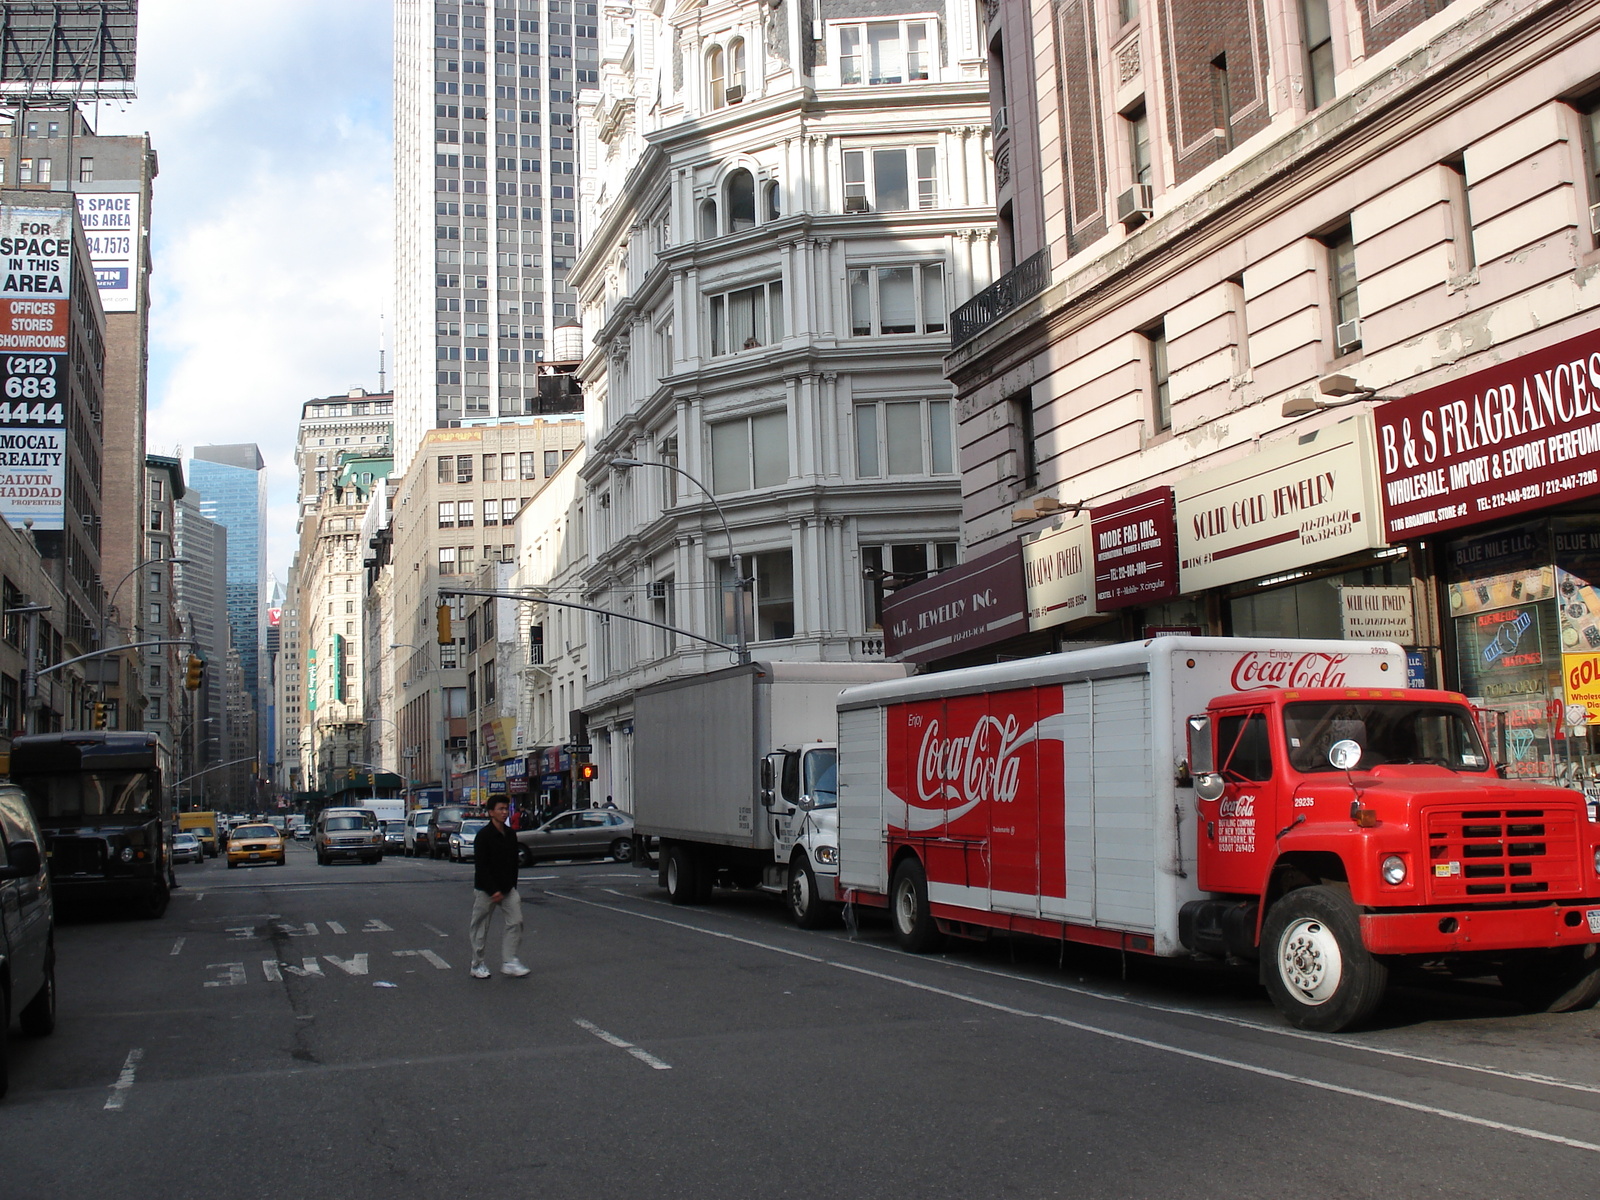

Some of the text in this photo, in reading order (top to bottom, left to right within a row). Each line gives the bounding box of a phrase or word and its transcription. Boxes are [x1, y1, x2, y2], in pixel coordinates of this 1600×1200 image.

[89, 199, 131, 211] SPACE
[80, 214, 131, 226] HIS AREA
[20, 222, 50, 235] FOR
[0, 238, 70, 257] SPACE
[9, 259, 60, 272] IN THIS
[3, 274, 63, 293] AREA
[10, 301, 56, 315] OFFICES
[11, 318, 54, 331] STORES
[0, 334, 66, 348] SHOWROOMS
[6, 356, 57, 376] (212)
[5, 376, 56, 399] 683
[0, 402, 64, 424] 4444
[1382, 352, 1600, 475] B & S FRAGRANCES
[0, 435, 59, 449] MOCAL
[0, 452, 62, 466] REALTY
[0, 474, 53, 485] CALVIN
[1387, 468, 1450, 507] WHOLESALE,
[1450, 456, 1490, 491] IMPORT
[1492, 453, 1502, 480] &
[1503, 439, 1547, 477] EXPORT
[0, 487, 62, 498] HADDAD
[1405, 510, 1438, 529] BROADWAY,
[1437, 505, 1457, 521] STORE
[1457, 502, 1468, 517] #2
[1476, 497, 1492, 512] TEL:
[1545, 469, 1598, 495] 212-447-7206
[1193, 469, 1337, 541] SOLID GOLD JEWELRY
[1099, 519, 1157, 550] MODE FAB INC.
[1456, 534, 1535, 565] BLUE NILE LLC.
[1556, 534, 1587, 551] BLUE
[1145, 579, 1165, 592] cingular
[917, 598, 967, 631] JEWELRY
[972, 588, 998, 612] INC.
[1269, 649, 1293, 659] Enjoy
[1408, 658, 1422, 666] LLC.
[908, 713, 923, 727] Enjoy
[1294, 798, 1314, 807] 29235
[1248, 836, 1255, 844] NY
